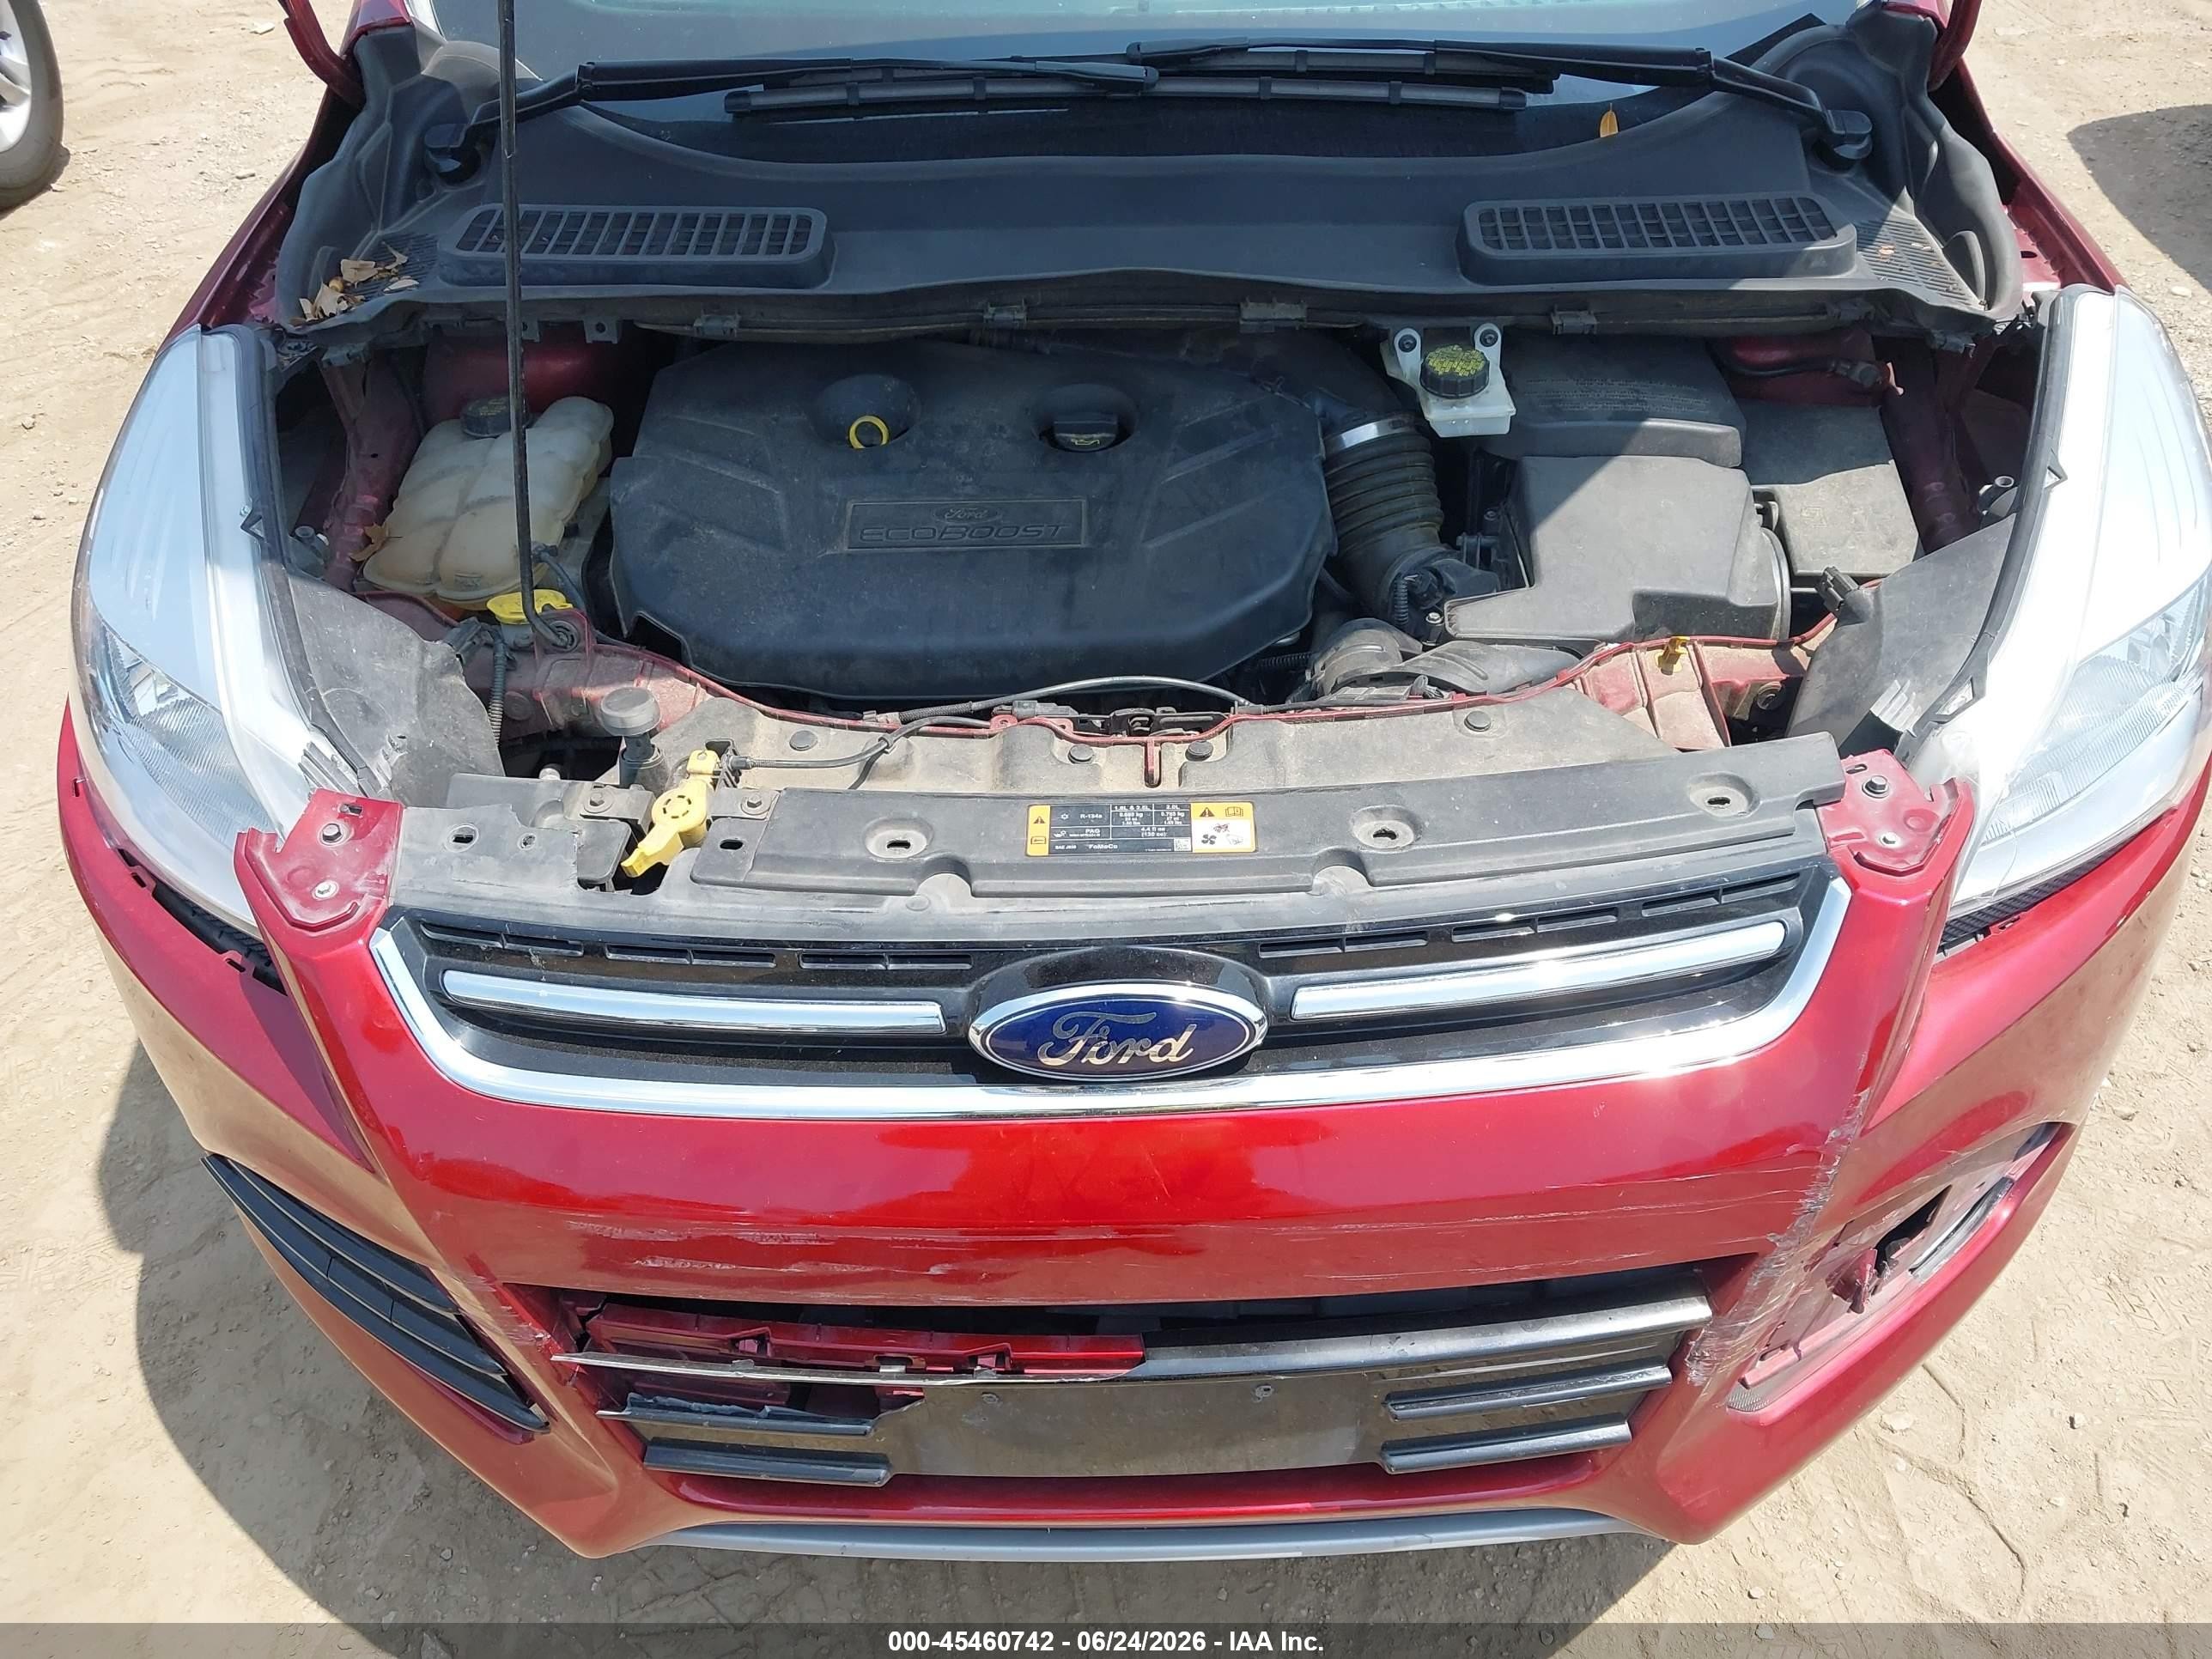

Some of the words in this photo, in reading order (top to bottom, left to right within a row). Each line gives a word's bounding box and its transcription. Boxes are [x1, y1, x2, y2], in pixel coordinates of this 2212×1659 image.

[944, 507, 990, 520] Ford
[860, 523, 1072, 543] ECOBOOST
[1036, 1011, 1198, 1067] Ford
